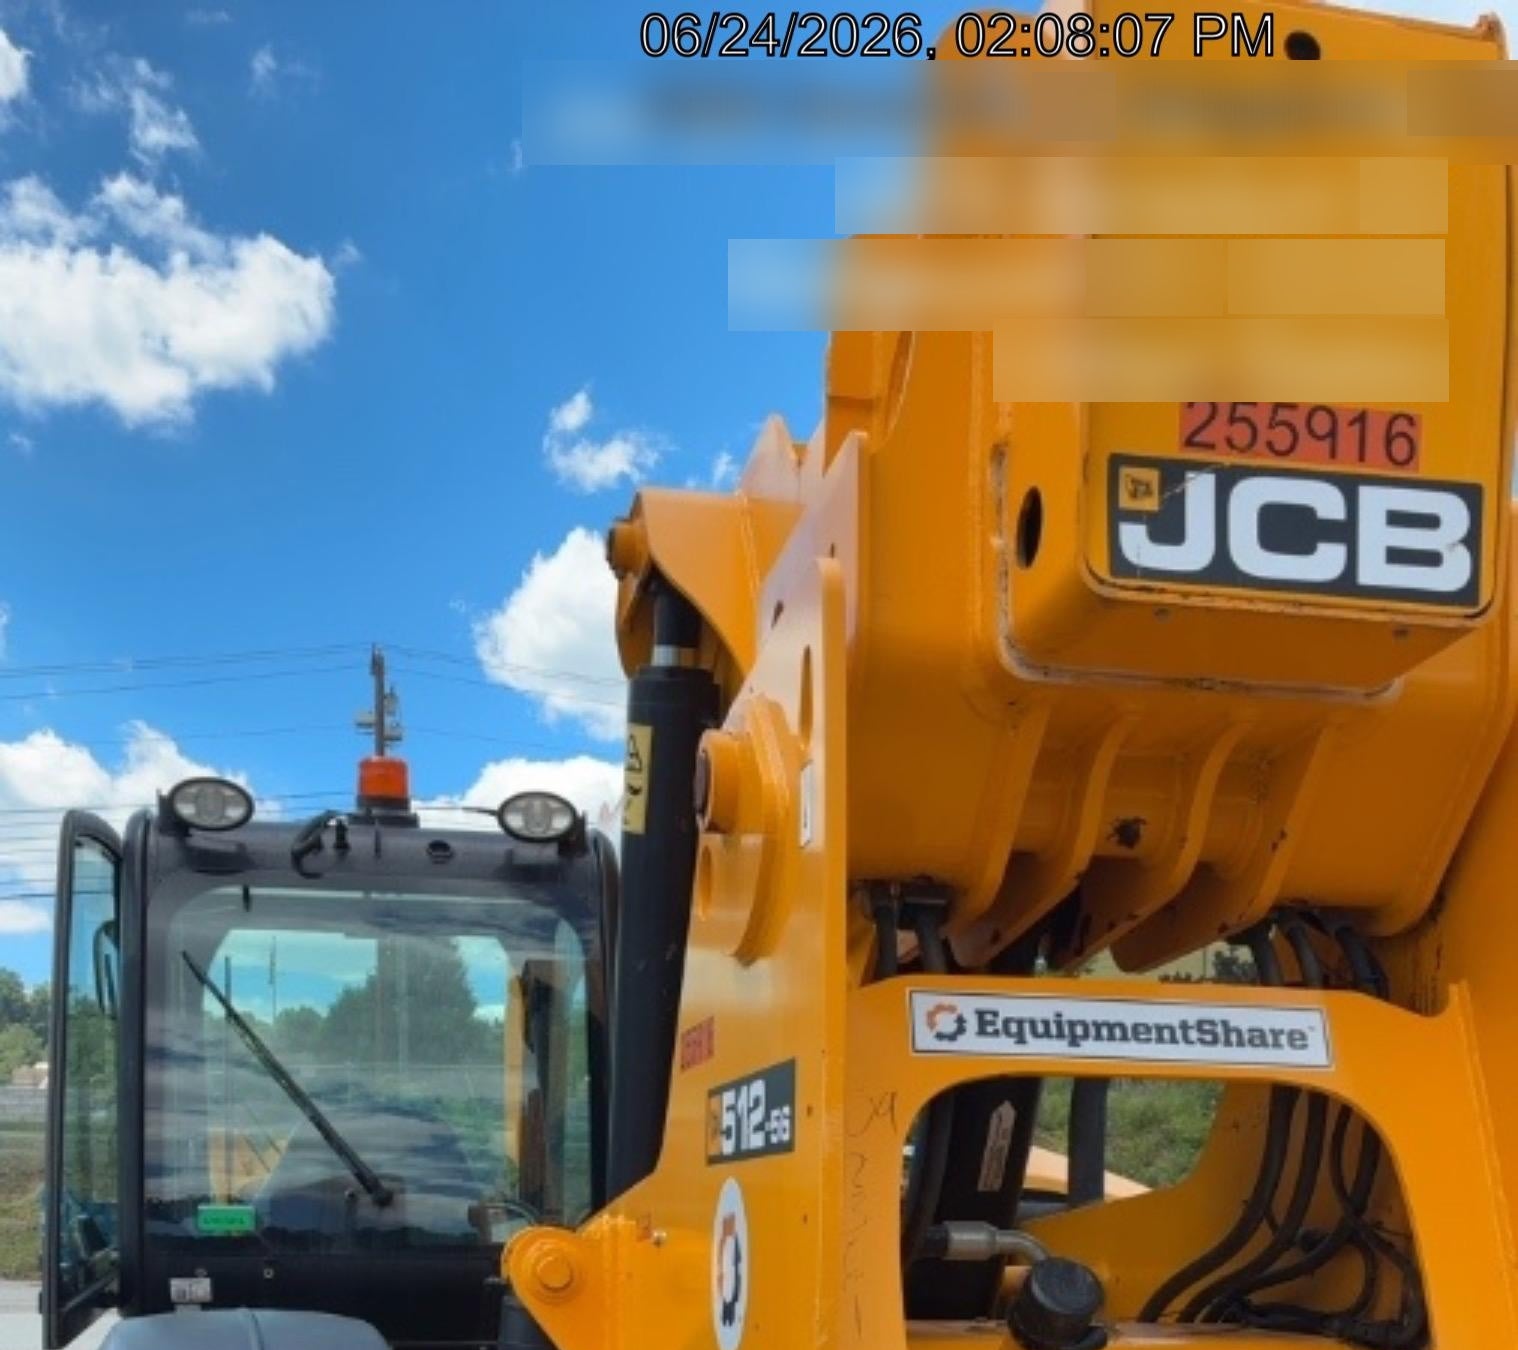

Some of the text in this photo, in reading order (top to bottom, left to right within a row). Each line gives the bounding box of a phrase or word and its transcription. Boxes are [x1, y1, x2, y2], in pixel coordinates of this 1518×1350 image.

[1183, 402, 1419, 466] 255916
[1118, 471, 1472, 592] JCB
[974, 1009, 1310, 1050] EquipmentShare
